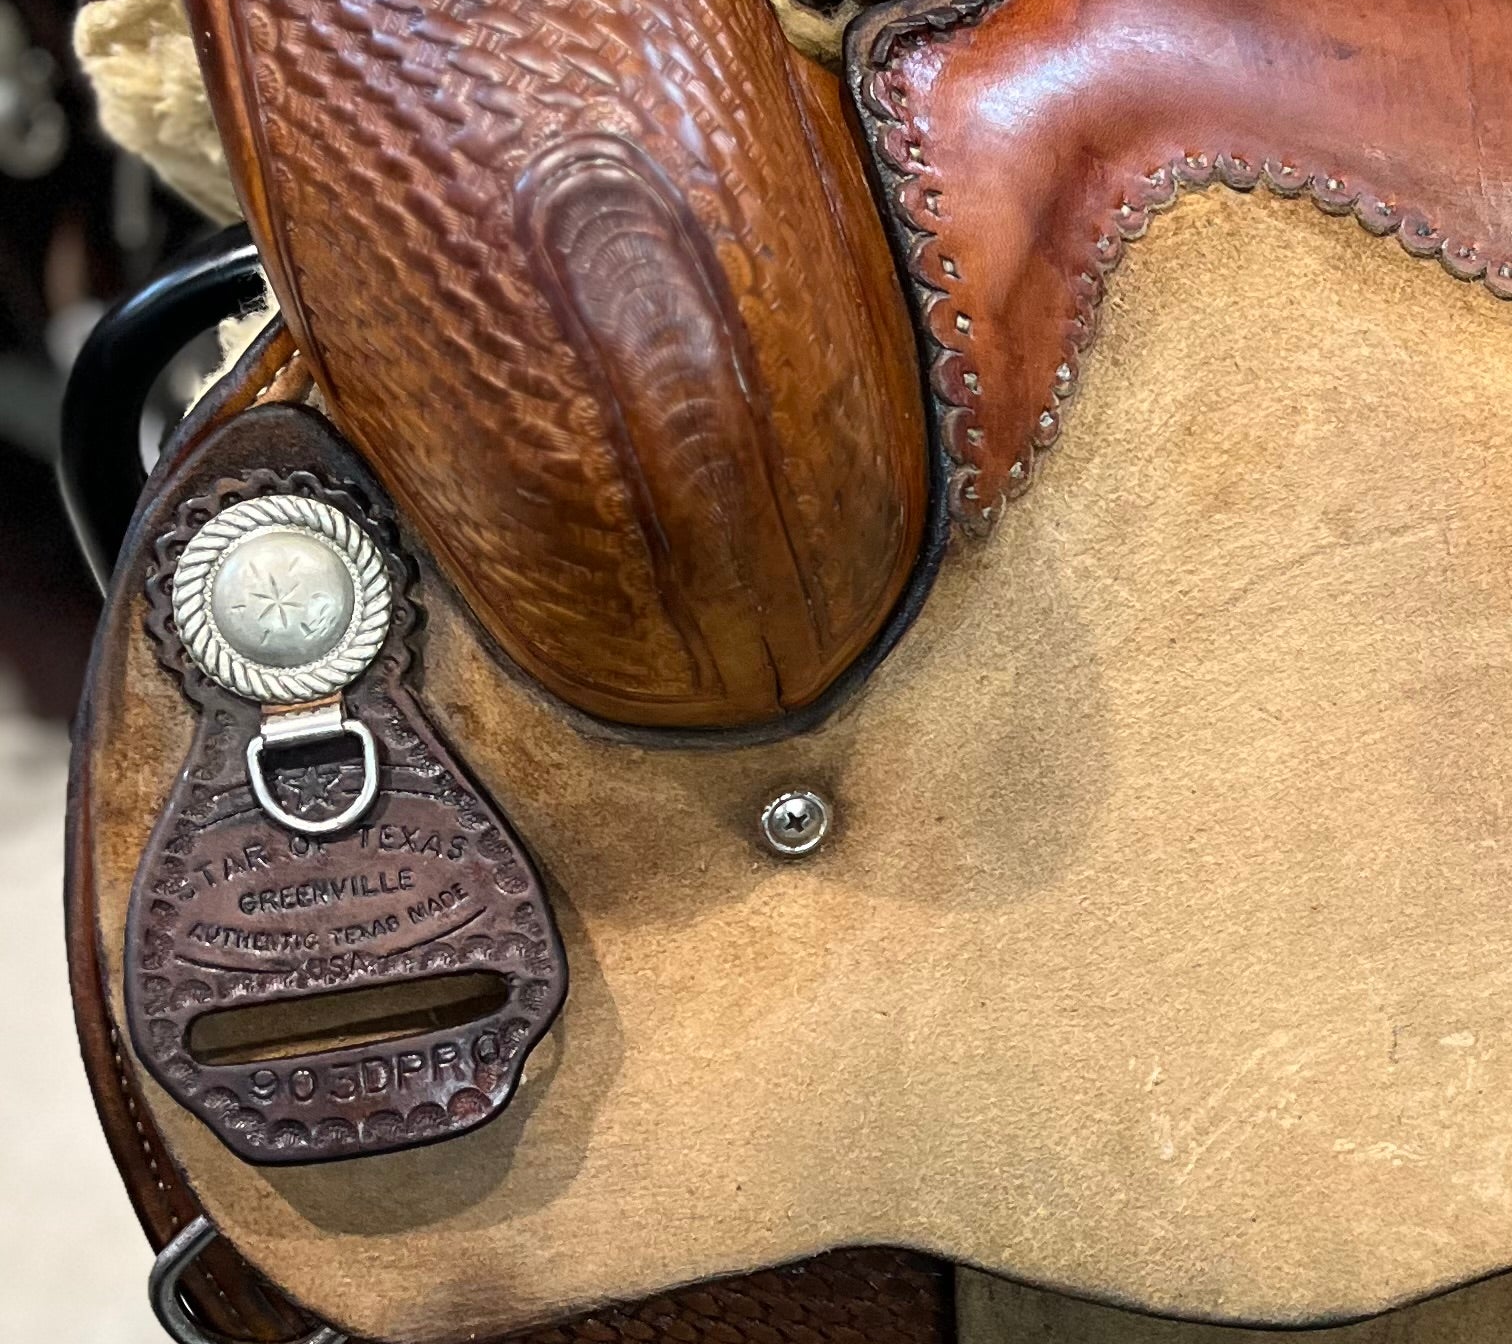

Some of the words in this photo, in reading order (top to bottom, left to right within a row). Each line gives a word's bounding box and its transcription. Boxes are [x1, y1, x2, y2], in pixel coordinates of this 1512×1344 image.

[176, 842, 271, 903] TAR
[358, 823, 469, 860] TEXAS
[238, 868, 415, 916] GREENVILLE
[188, 921, 319, 951] AUTHENTIC
[328, 915, 400, 946] TEXAS
[407, 882, 469, 925] MADE
